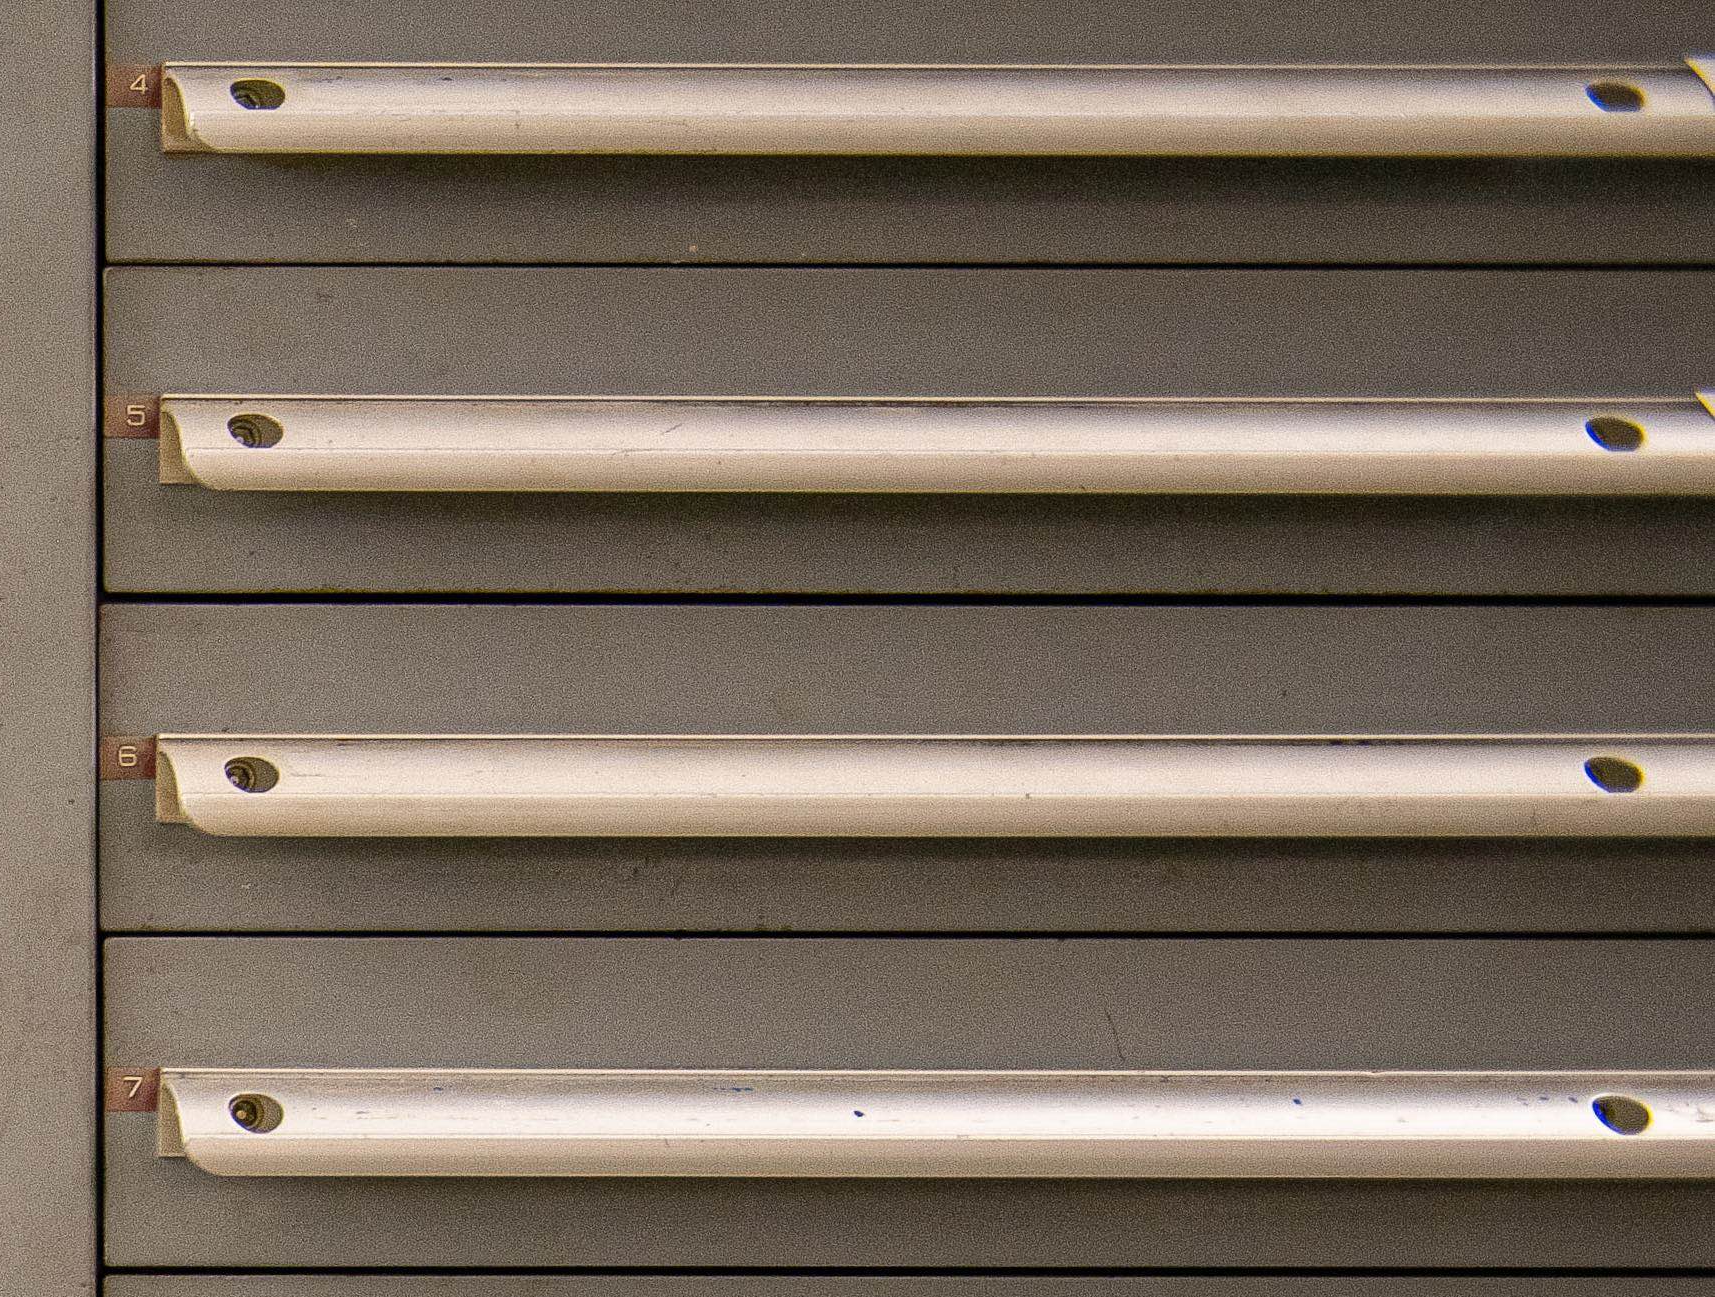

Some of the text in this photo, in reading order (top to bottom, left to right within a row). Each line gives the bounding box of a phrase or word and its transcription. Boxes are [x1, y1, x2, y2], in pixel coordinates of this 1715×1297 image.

[130, 73, 148, 95] 4
[127, 404, 146, 427] 5
[118, 744, 137, 767] 6
[123, 1075, 143, 1098] 7
